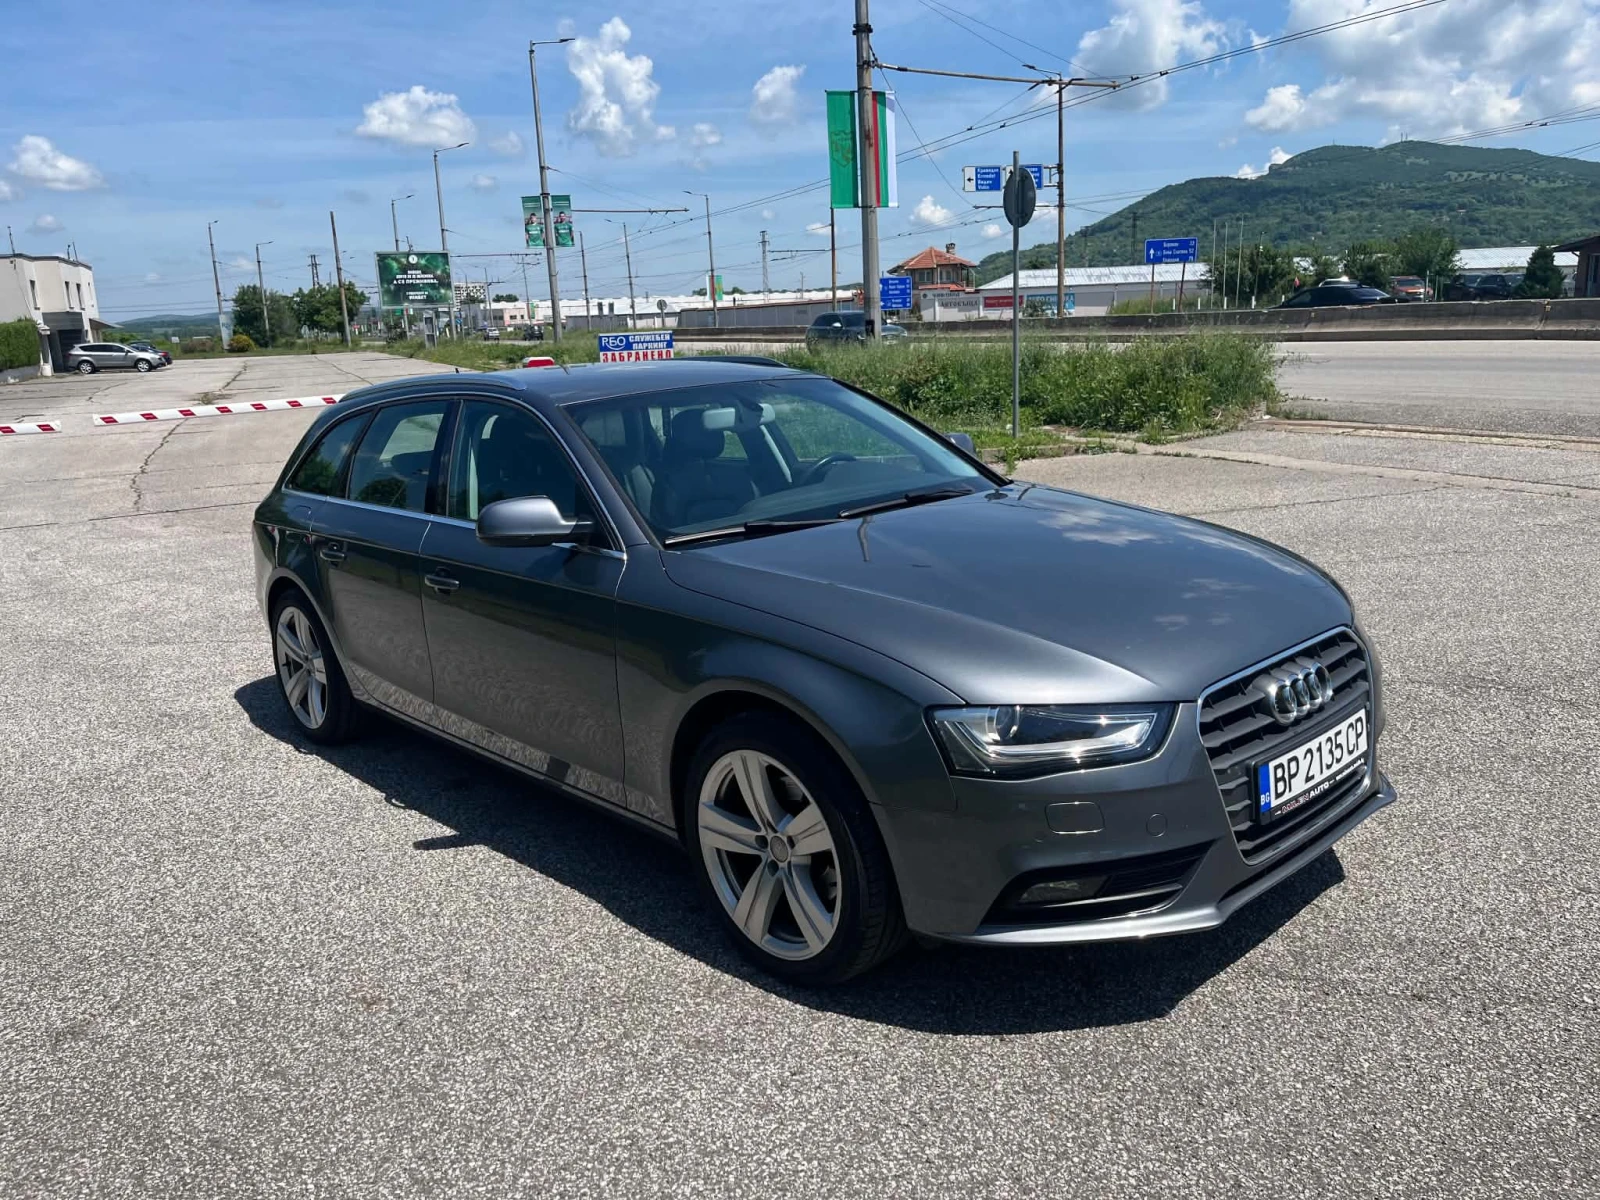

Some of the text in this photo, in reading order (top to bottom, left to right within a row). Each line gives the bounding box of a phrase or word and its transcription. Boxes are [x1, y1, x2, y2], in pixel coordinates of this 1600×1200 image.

[629, 334, 670, 342] СЛУЖЕБЕН
[632, 342, 668, 350] ПАРКИНГ
[602, 350, 672, 363] ЗАБРАНЕНО
[1273, 755, 1300, 801] BP
[1303, 729, 1344, 785] 2135
[1346, 716, 1364, 756] CP
[1309, 781, 1330, 799] AUTO
[1260, 792, 1270, 805] BG
